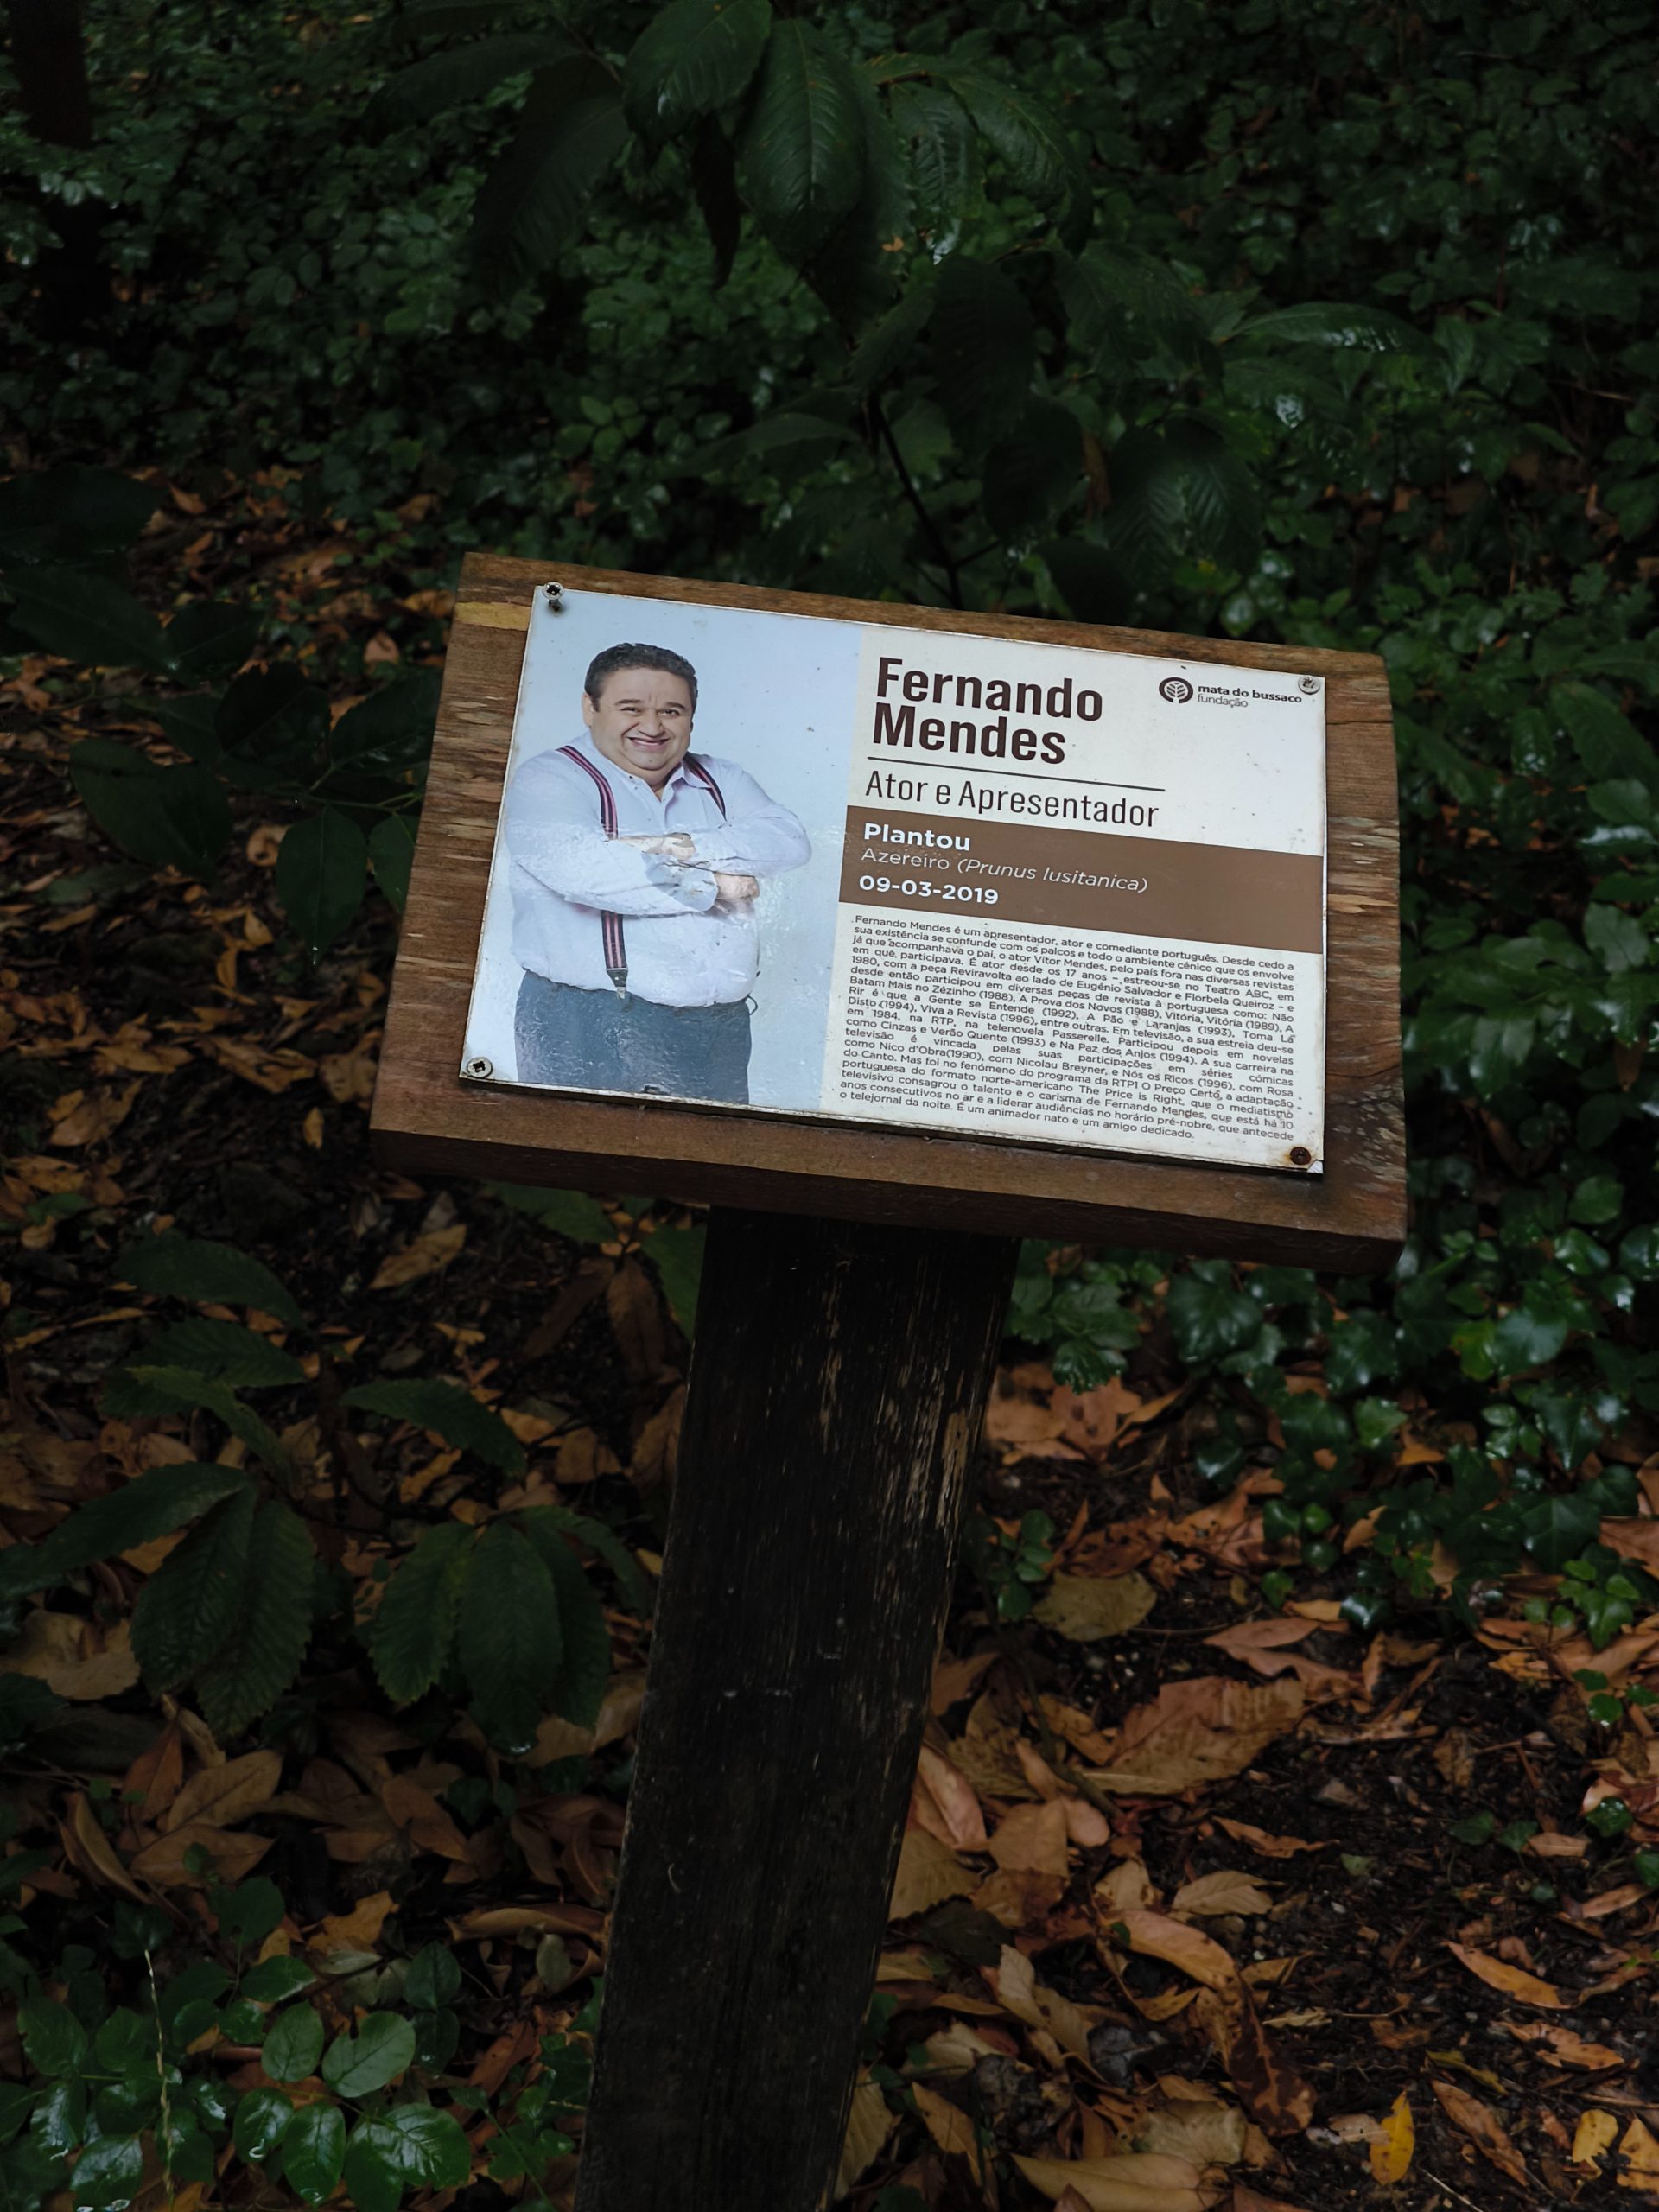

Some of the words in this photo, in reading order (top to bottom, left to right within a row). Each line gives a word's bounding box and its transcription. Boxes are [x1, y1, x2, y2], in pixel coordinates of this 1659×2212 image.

[877, 658, 1102, 721] Fernando
[1198, 685, 1230, 696] mata
[1232, 688, 1249, 697] do
[1252, 690, 1303, 703] bussaco
[1198, 694, 1249, 708] fundação
[874, 702, 1065, 764] Mendes
[866, 771, 928, 801] Ator
[937, 785, 950, 804] e
[958, 781, 1159, 827] Apresentador
[865, 823, 969, 850] Plantou
[860, 876, 998, 904] 09-03-2019
[861, 849, 949, 869] Azereiro
[958, 859, 1036, 879] (Prunus
[1043, 868, 1147, 893] lusitanica)
[855, 915, 907, 928] Fernando
[909, 921, 951, 933] Mendes
[1060, 938, 1084, 948] ator
[1095, 943, 1160, 957] comediante
[1222, 956, 1256, 967] Desde
[1257, 961, 1286, 969] cedo
[874, 929, 930, 941] existência
[945, 937, 998, 948] confunde
[1040, 947, 1077, 957] palcos
[1087, 950, 1113, 961] todo
[1124, 956, 1175, 968] ambiente
[1177, 962, 1213, 972] cénico
[1251, 970, 1294, 981] envolve
[850, 966, 885, 976] desde
[887, 971, 920, 981] então
[925, 975, 982, 988] participou
[1007, 983, 1053, 995] diversas
[1058, 989, 1090, 1000] peças
[1114, 996, 1151, 1007] revista
[1166, 1002, 1229, 1016] portuguesa
[1232, 1010, 1268, 1020] como:
[919, 964, 947, 974] peça
[950, 966, 1013, 981] Reviravolta
[1032, 976, 1057, 986] lado
[1077, 981, 1122, 993] Eugénio
[1123, 986, 1173, 998] Salvador
[1185, 993, 1230, 1005] Florbela
[1231, 998, 1275, 1011] Queiroz
[982, 960, 1006, 969] ator
[1009, 963, 1044, 974] desde
[1081, 971, 1108, 981] anos
[1123, 976, 1181, 989] estreou-se
[1204, 984, 1241, 995] Teatro
[1007, 953, 1032, 962] ator
[1033, 955, 1062, 965] Vítor
[1109, 964, 1135, 974] pelo
[1135, 968, 1159, 977] país
[1160, 969, 1183, 979] fora
[1205, 975, 1250, 987] diversas
[1252, 981, 1294, 991] revistas
[848, 996, 877, 1007] Disto
[919, 1004, 944, 1014] Viva
[957, 1008, 997, 1020] Revista
[1039, 1019, 1070, 1028] entre
[1217, 1039, 1255, 1050] estreia
[1256, 1043, 1294, 1054] deu-se
[849, 976, 886, 987] Batam
[887, 980, 912, 990] Mais
[931, 985, 978, 997] Zézinho
[1030, 995, 1063, 1007] Prova
[1087, 1002, 1123, 1014] Novos
[1205, 1015, 1243, 1027] Vitória
[928, 995, 962, 1006] Gente
[988, 1001, 1035, 1014] Entende
[1145, 1019, 1192, 1033] Laranjas
[1242, 1030, 1274, 1041] Toma
[844, 1039, 876, 1048] como
[879, 1041, 906, 1052] Nico
[1016, 1057, 1058, 1069] Nicolau
[1164, 1074, 1195, 1085] Ricos
[1267, 1086, 1294, 1097] Rosa
[845, 1018, 878, 1028] como
[880, 1020, 917, 1033] Cinzas
[930, 1026, 963, 1037] Verão
[966, 1030, 1007, 1043] Quente
[1010, 1035, 1046, 1048] (1993)
[1125, 1048, 1157, 1060] Anjos
[1235, 1062, 1277, 1073] carreira
[845, 1027, 894, 1040] televisão
[933, 1038, 976, 1050] vincada
[992, 1045, 1022, 1055] pelas
[1037, 1050, 1063, 1059] suas
[1078, 1055, 1153, 1070] participações
[1201, 1069, 1234, 1079] séries
[1249, 1074, 1294, 1086] cómicas
[987, 1022, 1044, 1036] telenovela
[1118, 1037, 1174, 1052] Participou
[1181, 1045, 1219, 1057] depois
[1252, 1053, 1294, 1065] novelas
[842, 1059, 906, 1073] portuguesa
[931, 1068, 976, 1081] formato
[981, 1075, 1073, 1091] norte-americano
[1104, 1088, 1134, 1099] Price
[842, 1069, 894, 1083] televisivo
[898, 1077, 957, 1090] consagrou
[972, 1084, 1013, 1096] talento
[1039, 1092, 1082, 1103] carisma
[1104, 1098, 1158, 1113] Fernando
[1236, 1116, 1260, 1125] está
[960, 1061, 1016, 1075] fenómeno
[1037, 1071, 1091, 1084] programa
[1111, 1078, 1139, 1089] RTP1
[1154, 1083, 1186, 1096] Preço
[1235, 1095, 1294, 1109] adaptação
[840, 1081, 868, 1090] anos
[869, 1084, 943, 1098] consecutivos
[996, 1096, 1033, 1109] liderar
[1035, 1103, 1095, 1116] audiências
[1114, 1110, 1154, 1123] horário
[1242, 1128, 1294, 1141] antecede
[850, 1091, 902, 1105] telejornal
[988, 1108, 1041, 1120] animador
[1044, 1114, 1070, 1123] nato
[1102, 1121, 1138, 1133] amigo
